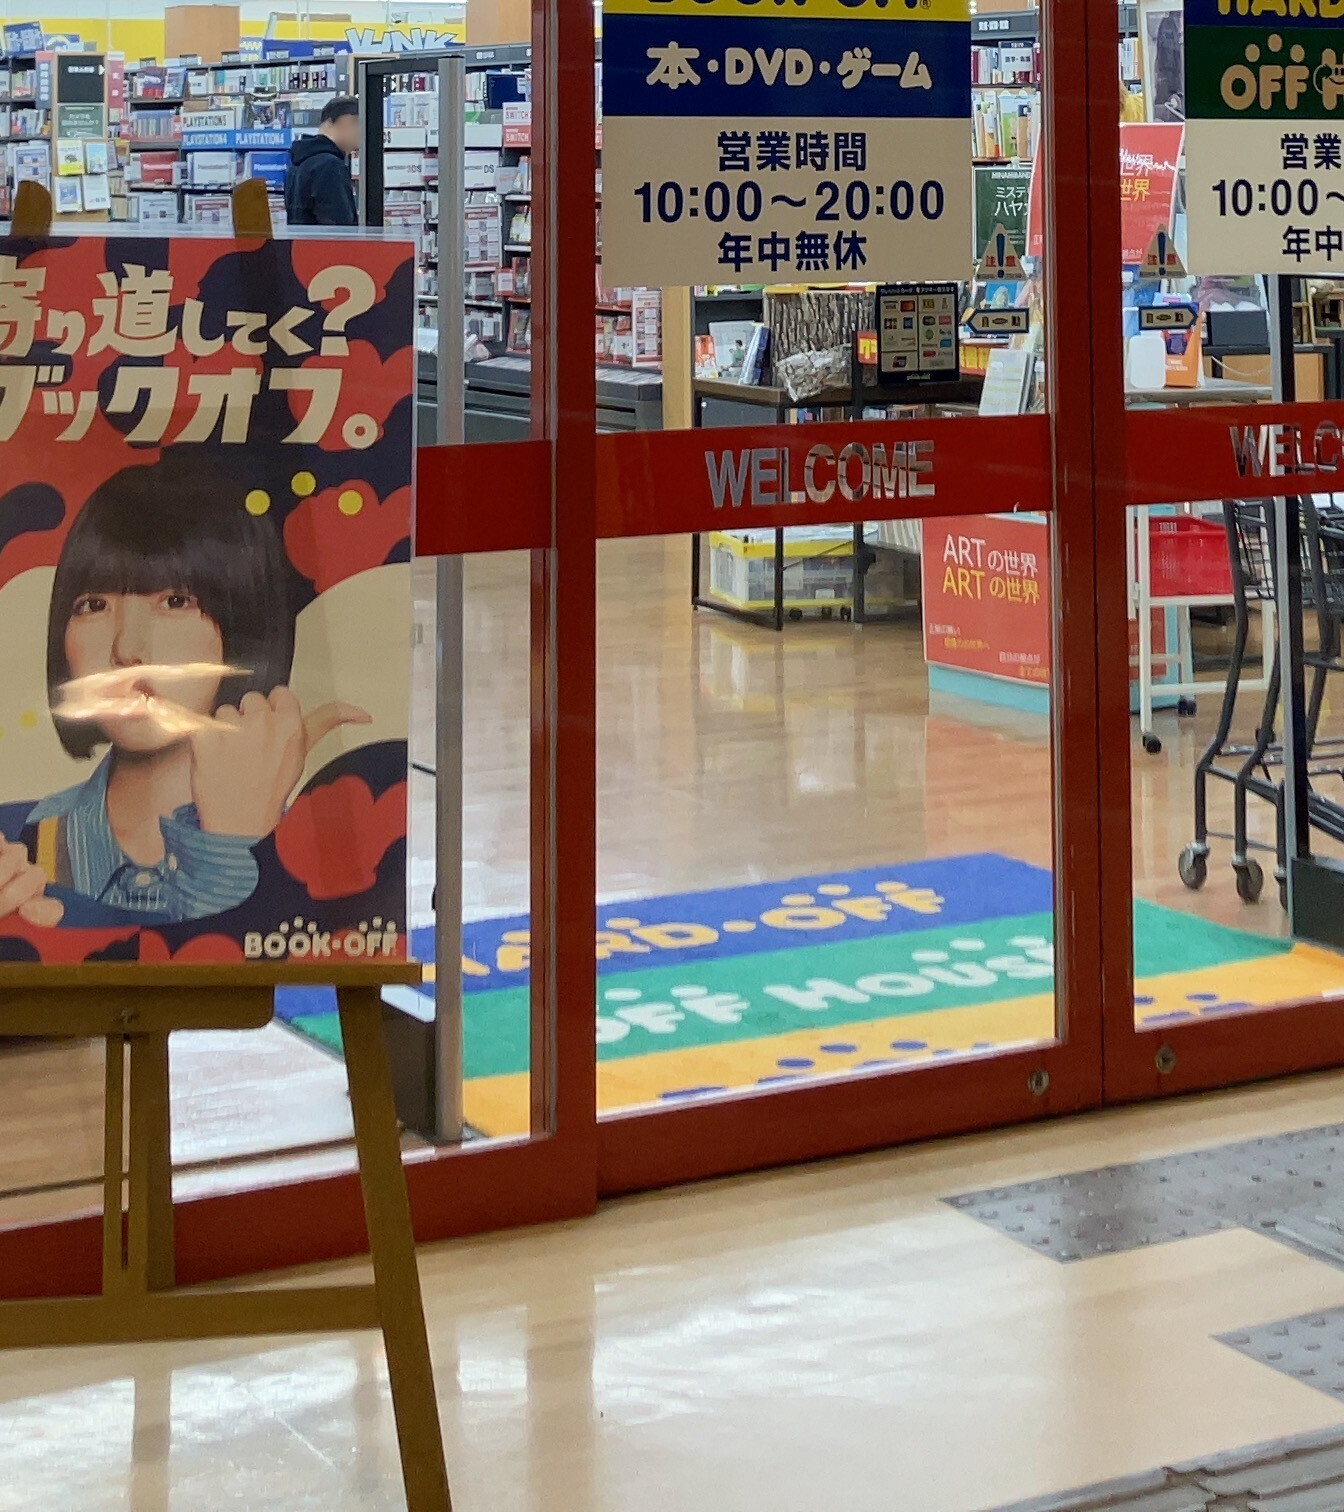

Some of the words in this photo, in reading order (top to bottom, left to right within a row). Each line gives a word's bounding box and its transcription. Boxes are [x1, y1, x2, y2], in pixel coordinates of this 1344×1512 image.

[1220, 63, 1309, 112] OFF
[717, 131, 868, 172] 営業時間
[717, 230, 868, 273] 年中無休
[704, 439, 936, 509] WELCOME
